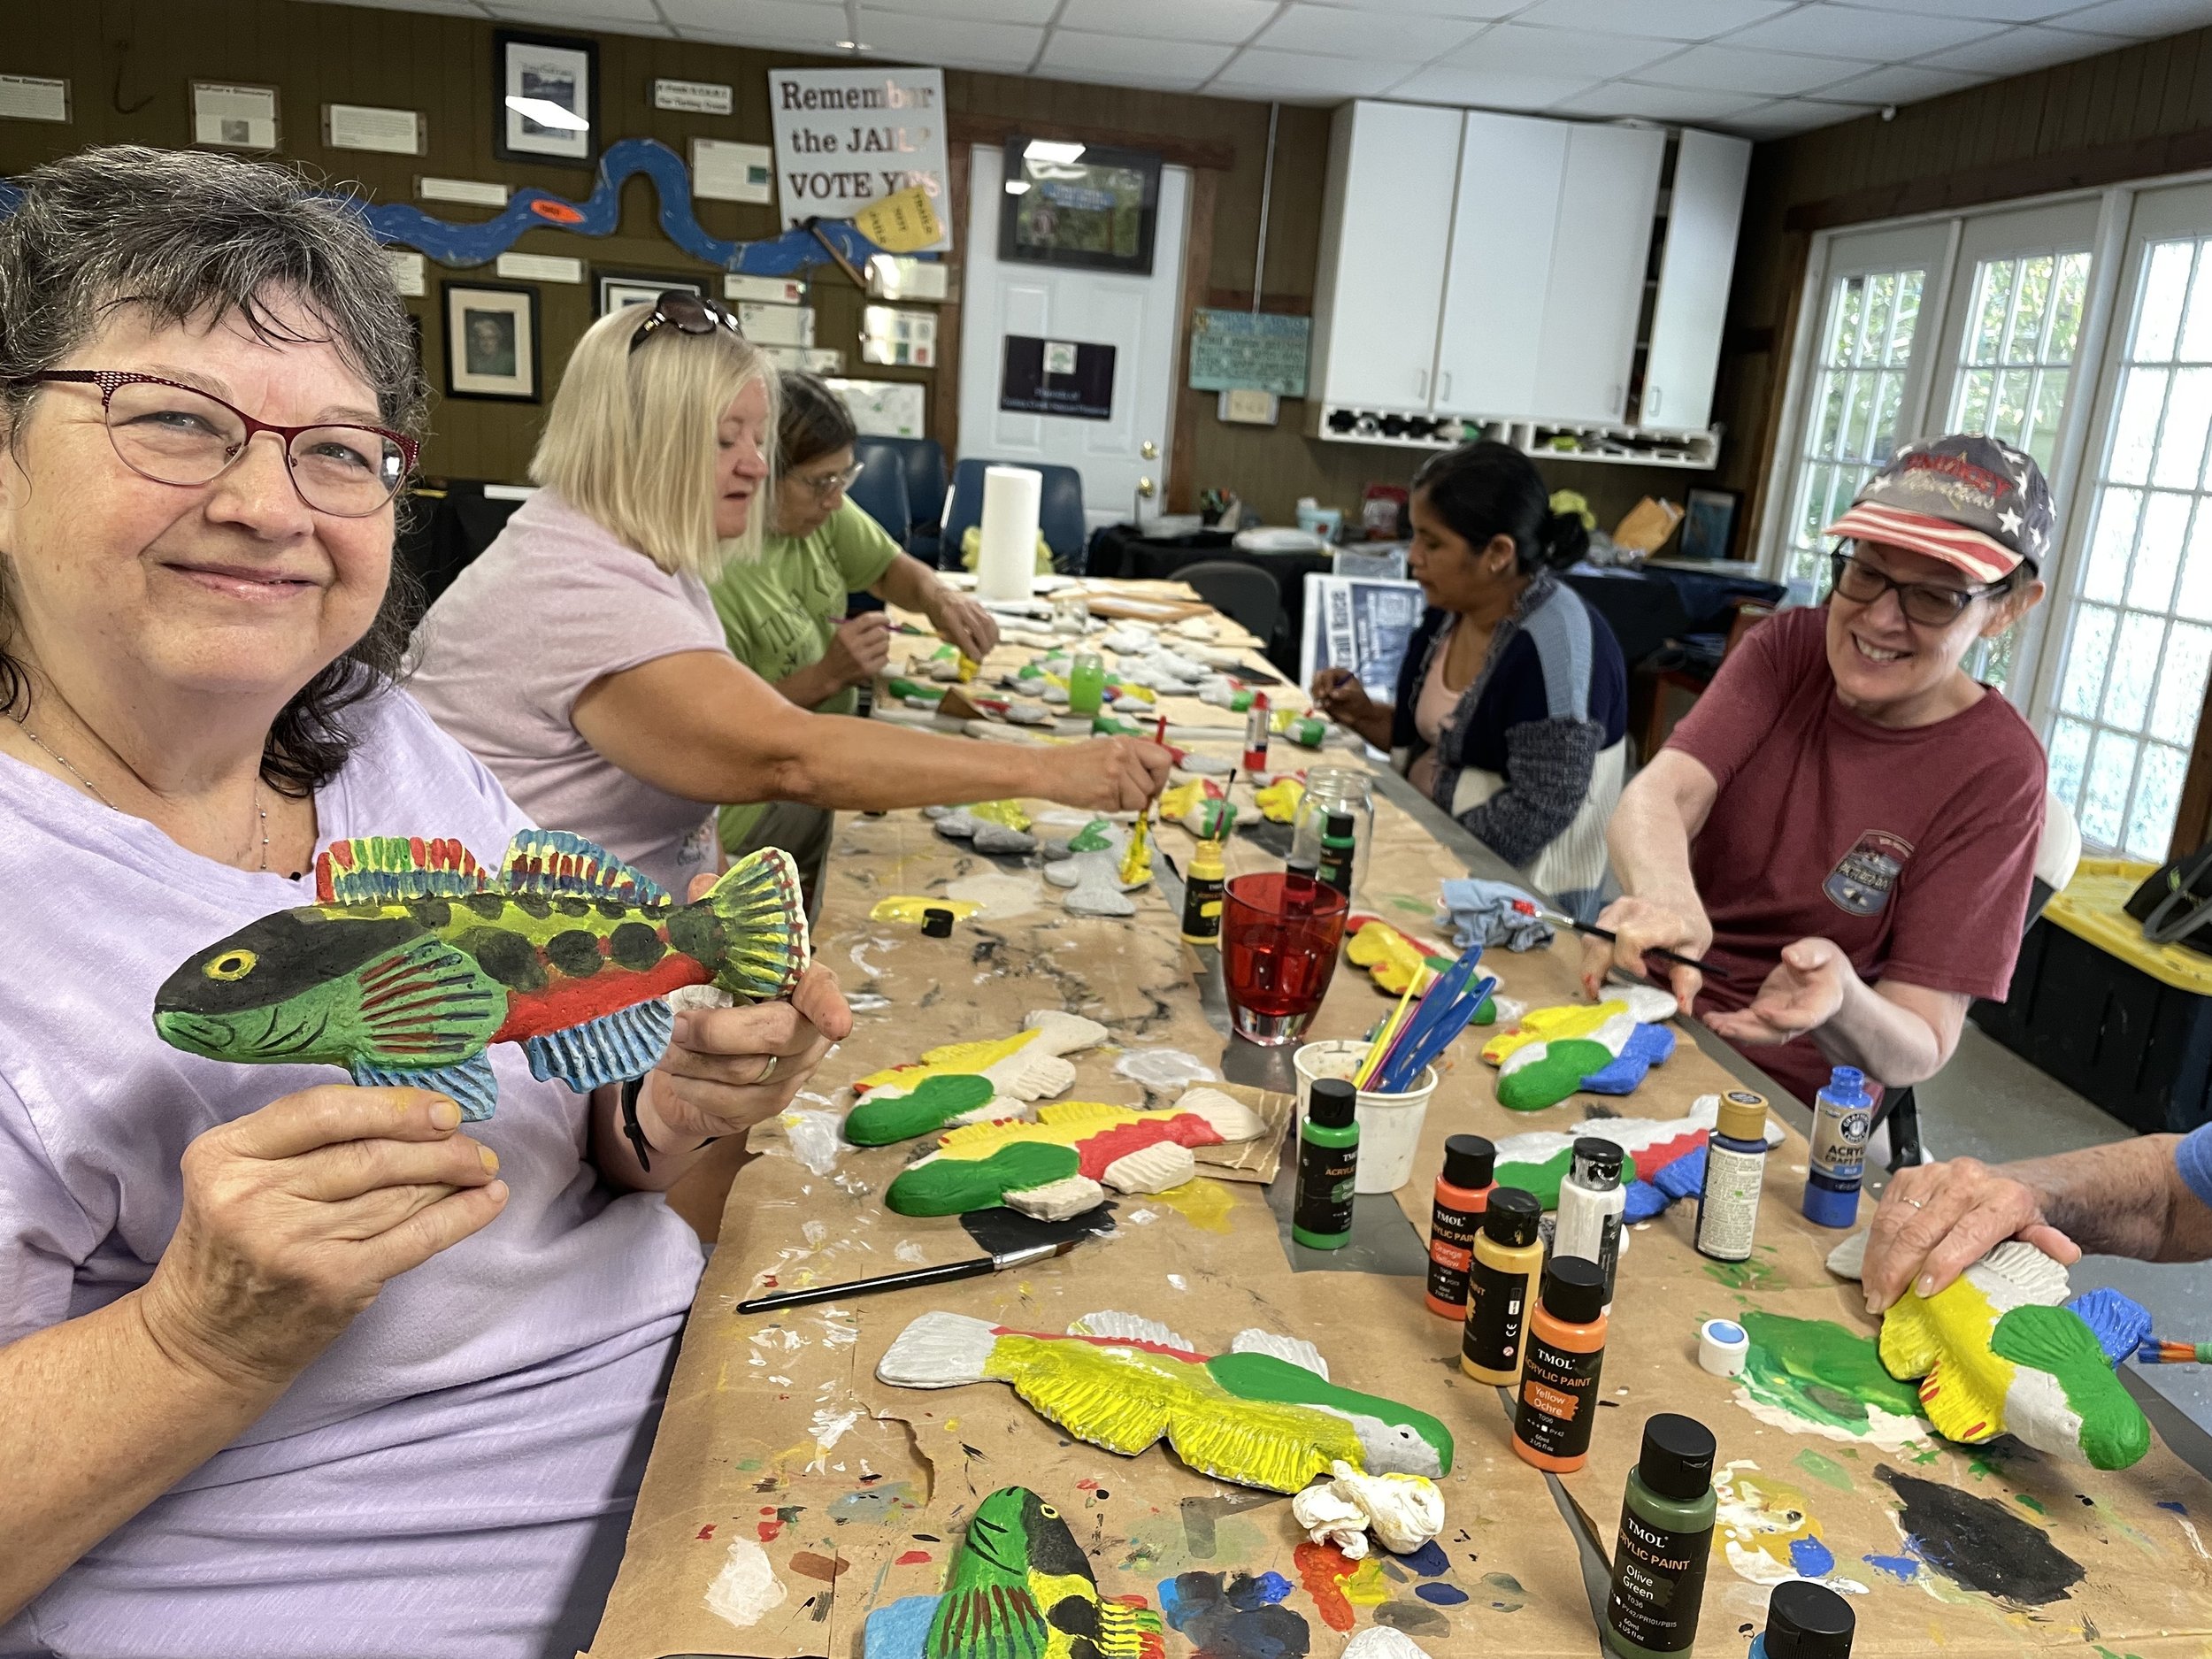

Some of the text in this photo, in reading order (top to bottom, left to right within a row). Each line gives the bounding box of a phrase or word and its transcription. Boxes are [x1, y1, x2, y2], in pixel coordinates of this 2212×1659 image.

[792, 127, 838, 153] the
[788, 172, 872, 198] VOTE
[1454, 1233, 1474, 1242] PAIN
[1436, 1254, 1459, 1268] Yellow
[1560, 1376, 1592, 1387] PAINT
[1535, 1386, 1565, 1405] Yellow
[1533, 1398, 1563, 1416] Ochre
[1651, 1555, 1690, 1571] PAINT
[1626, 1564, 1654, 1586] Olive
[1623, 1576, 1654, 1601] Green
[1627, 1594, 1644, 1609] T036
[1622, 1625, 1631, 1635] US
[1624, 1617, 1640, 1632] 60ml
